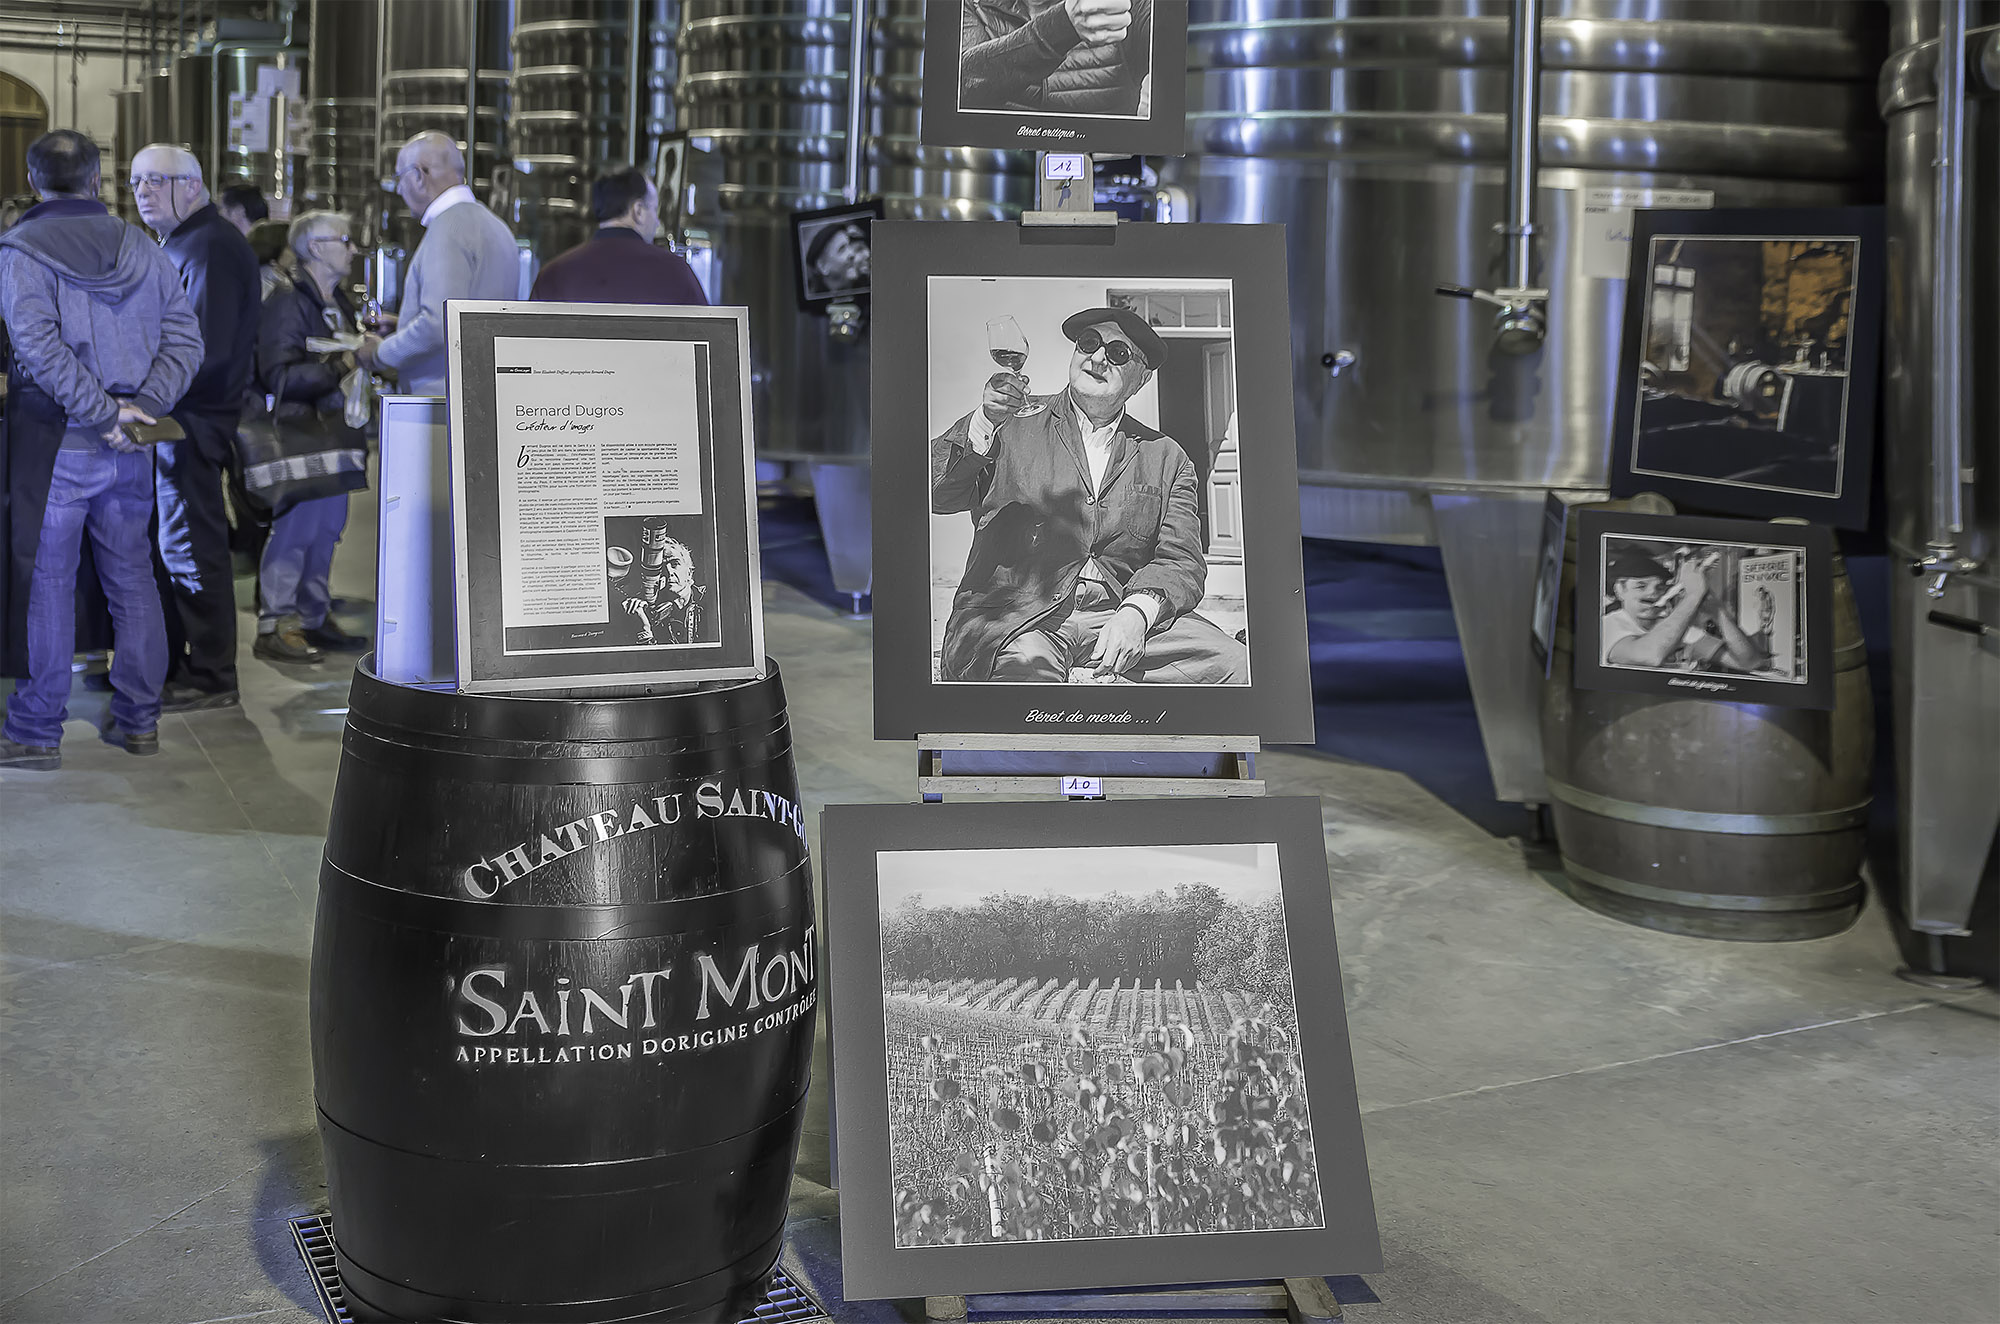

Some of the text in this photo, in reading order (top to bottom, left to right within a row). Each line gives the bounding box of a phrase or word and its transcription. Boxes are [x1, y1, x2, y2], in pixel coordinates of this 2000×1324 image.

[516, 405, 624, 418] Bernard Dugros
[516, 419, 594, 434] Créateur d'images
[1024, 709, 1065, 723] Béret
[1065, 709, 1084, 723] de
[1086, 710, 1132, 724] merde
[463, 793, 682, 899] CHATEAU
[456, 1042, 632, 1064] APPELLATION
